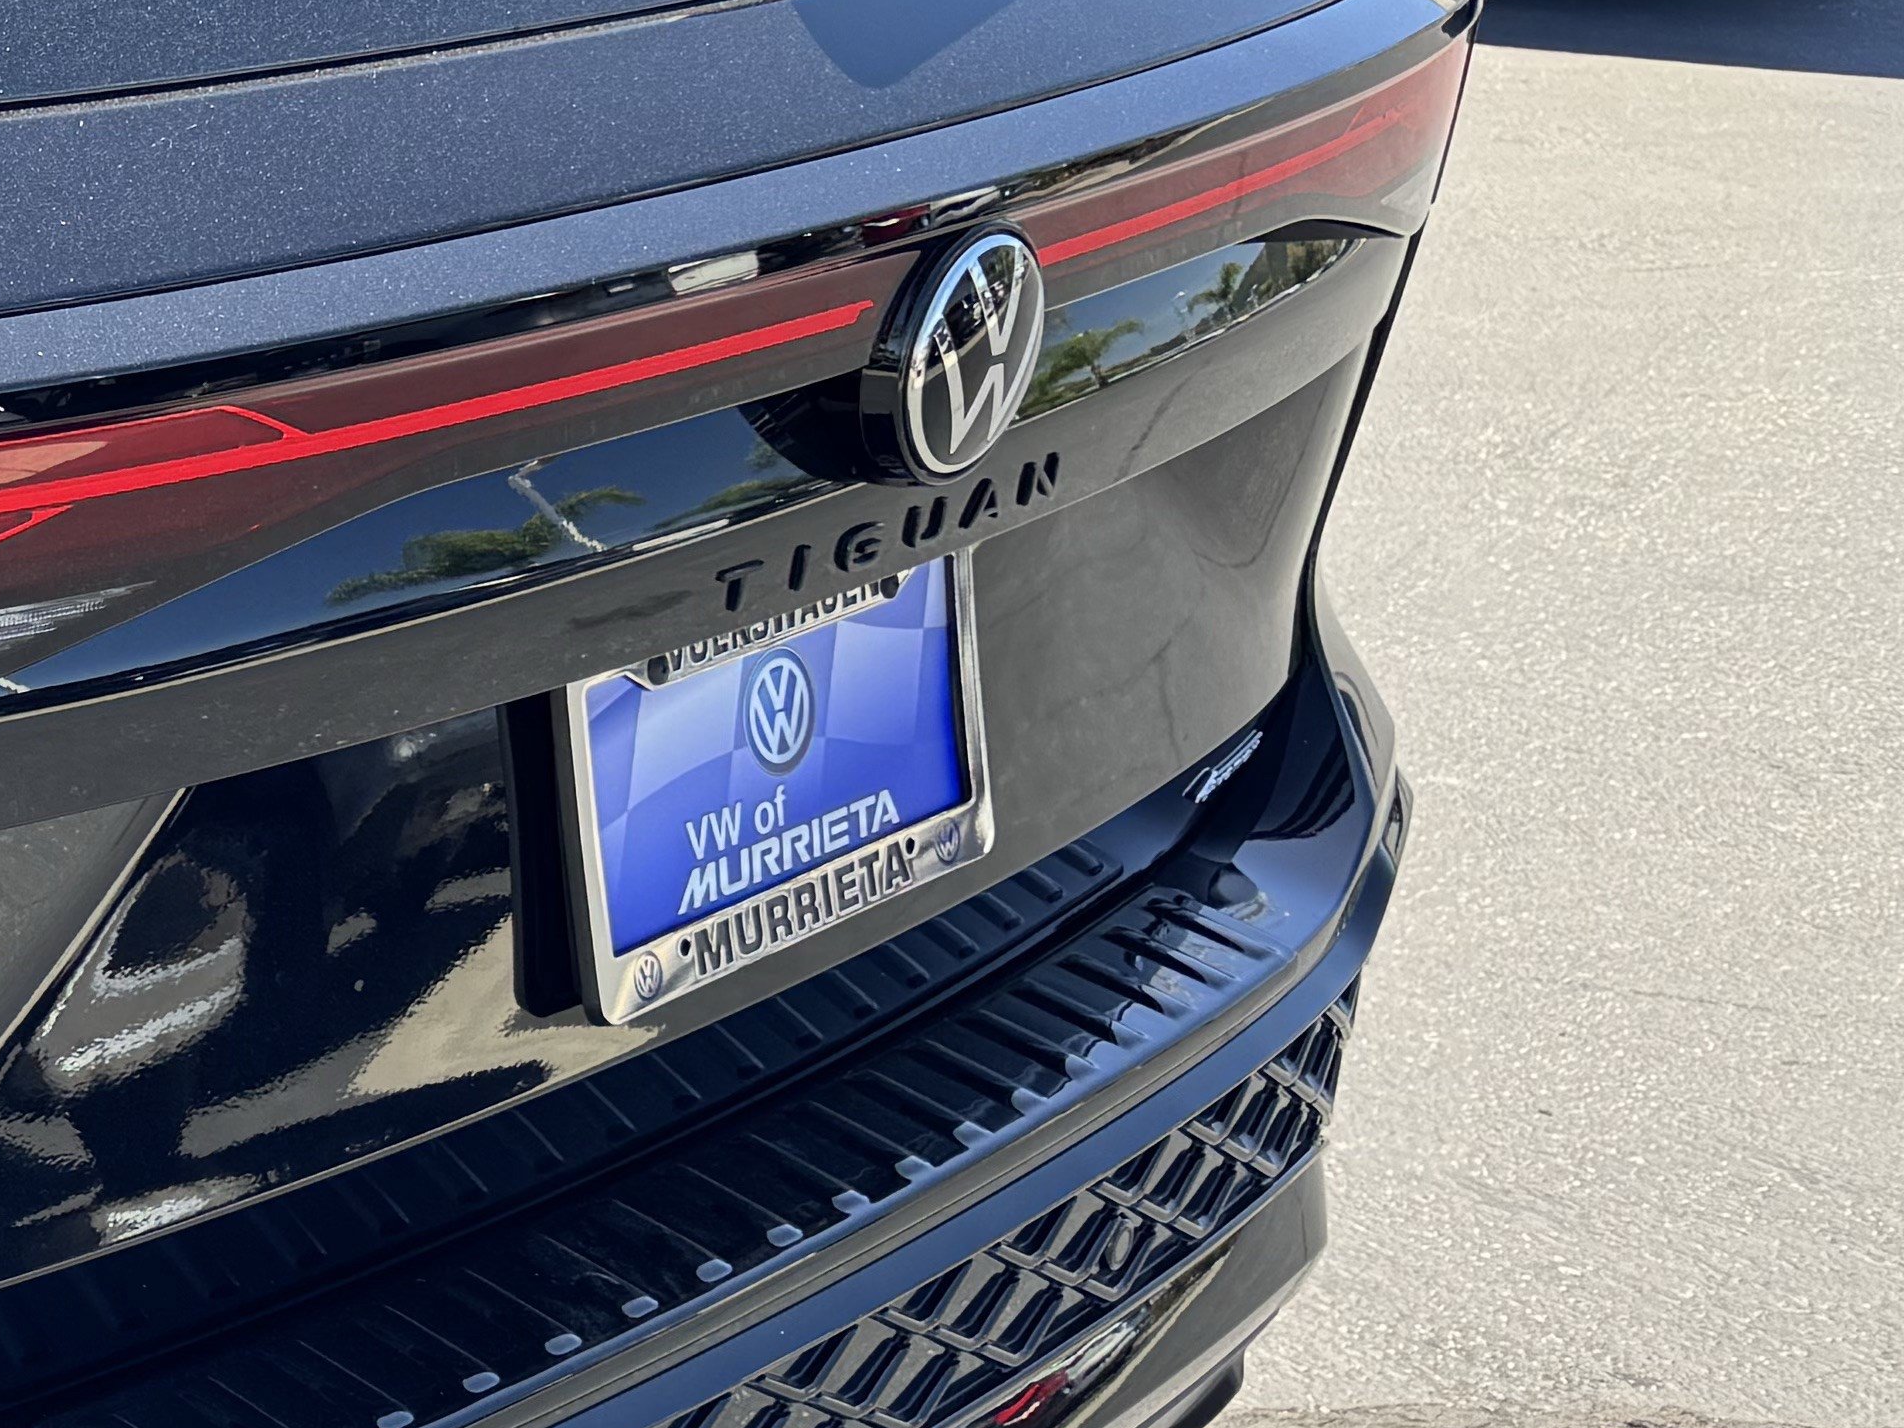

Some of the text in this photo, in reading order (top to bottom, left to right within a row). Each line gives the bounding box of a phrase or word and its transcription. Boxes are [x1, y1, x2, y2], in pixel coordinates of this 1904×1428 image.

[714, 451, 1062, 613] TIGUAN
[677, 788, 901, 916] MURRIETA
[685, 784, 786, 861] VW of
[693, 840, 912, 976] MURRIETA
